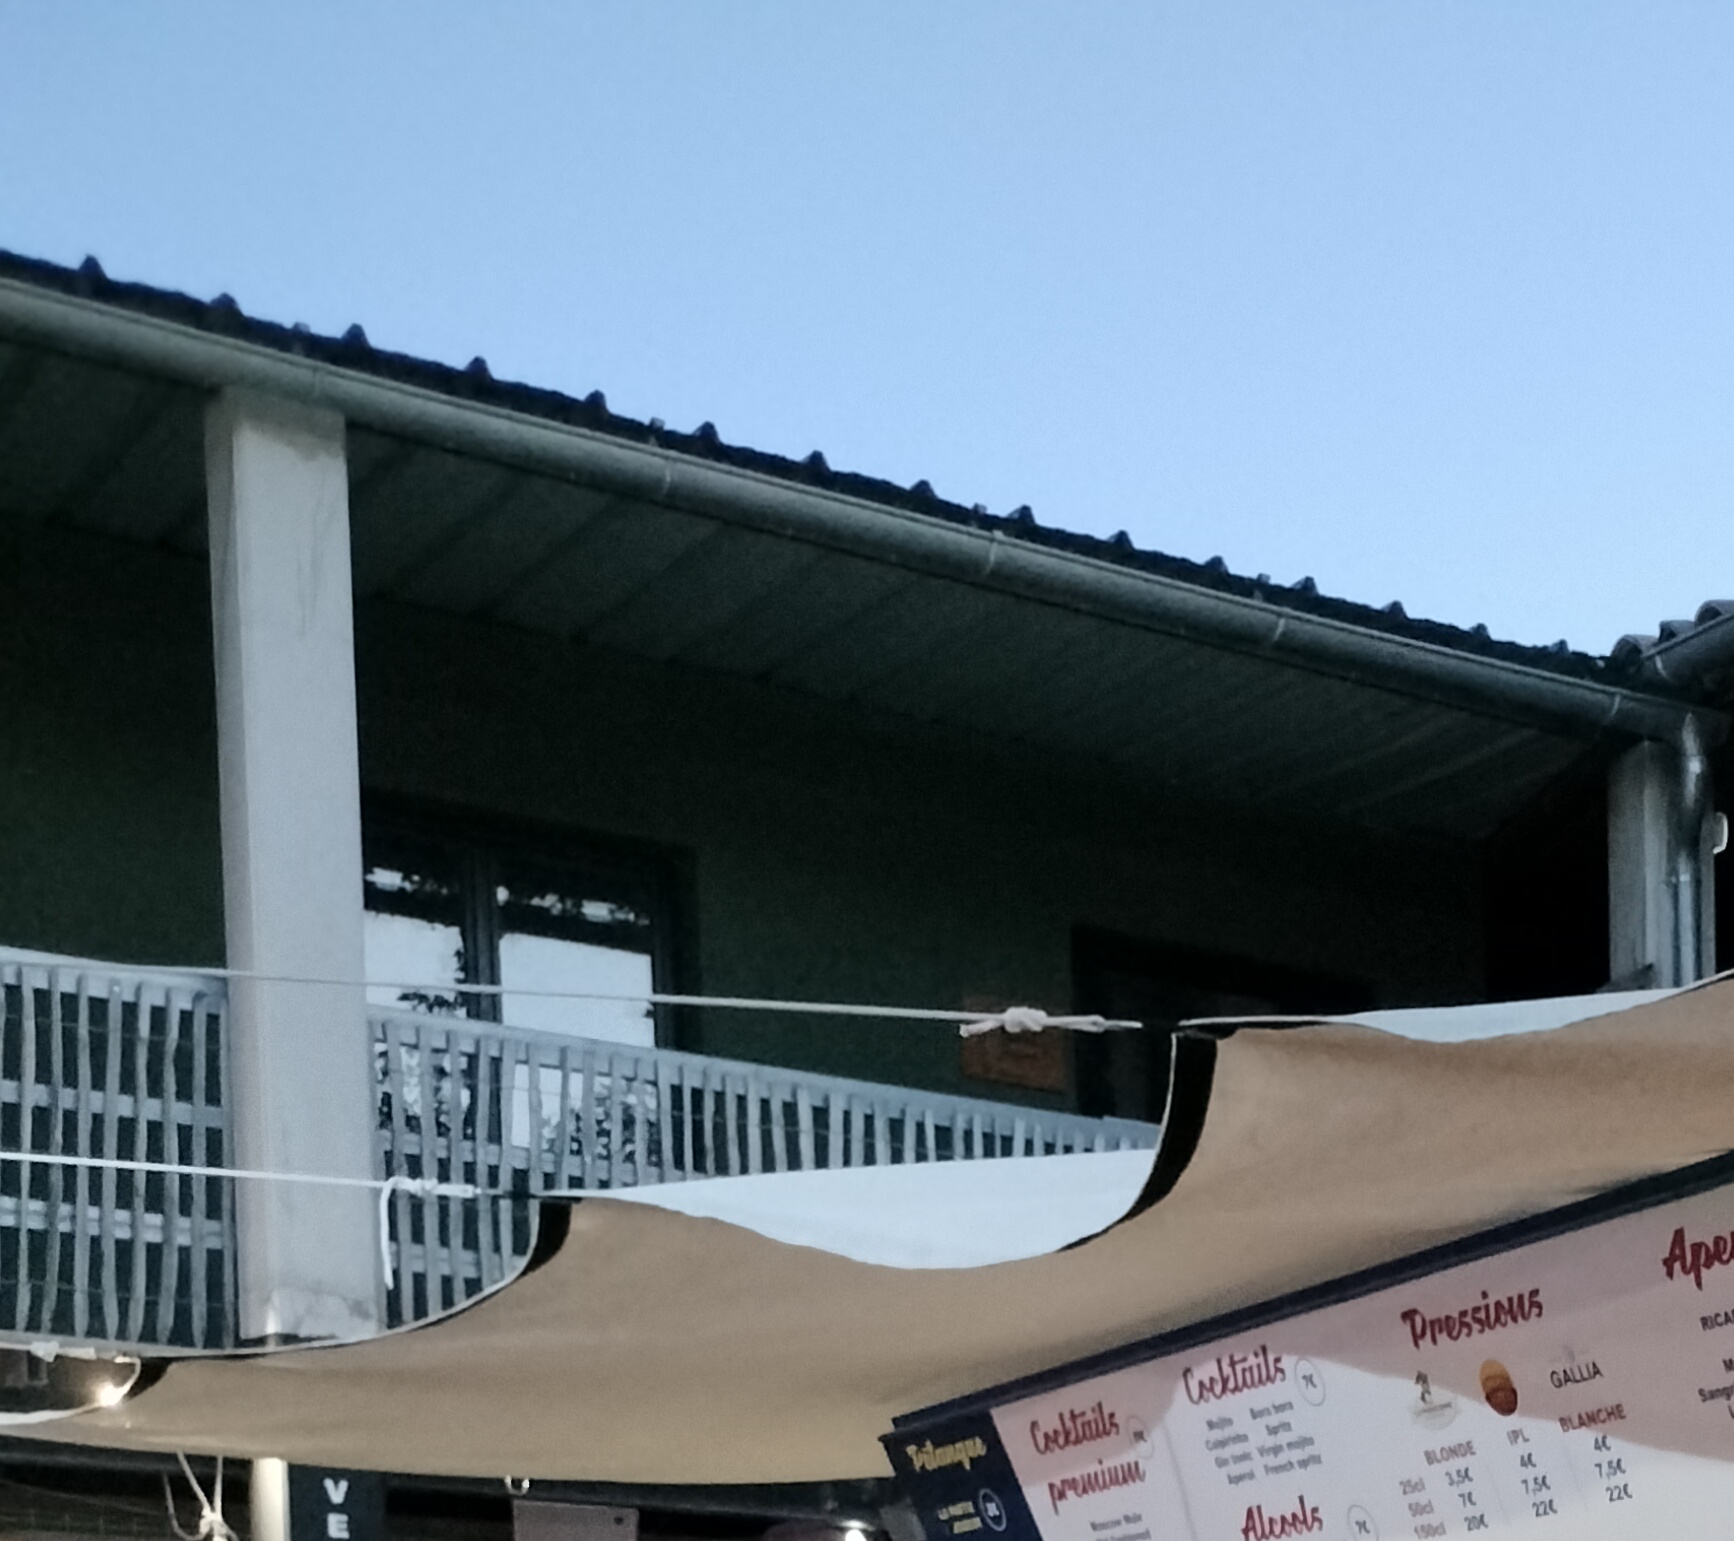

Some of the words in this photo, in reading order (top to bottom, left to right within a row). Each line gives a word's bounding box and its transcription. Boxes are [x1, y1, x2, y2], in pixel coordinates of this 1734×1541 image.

[1400, 1288, 1543, 1350] Pressions
[1182, 1343, 1286, 1405] Cocktails
[1550, 1361, 1603, 1388] GALLIA
[1029, 1401, 1120, 1455] Cocktails
[1424, 1441, 1476, 1466] BLONDE
[1507, 1428, 1530, 1446] IPL
[1559, 1403, 1627, 1432] BLANCHE
[1048, 1458, 1146, 1516] premium
[1399, 1478, 1426, 1495] 25cl
[1445, 1467, 1474, 1487] 3,5€
[1519, 1452, 1537, 1468] 4€
[1594, 1435, 1611, 1451] 4€
[1458, 1491, 1477, 1507] 7€
[1521, 1476, 1551, 1495] 7,5€
[1594, 1458, 1626, 1480] 7,5€
[1464, 1514, 1488, 1532] 20€
[1532, 1499, 1558, 1517] 22€
[1606, 1483, 1633, 1502] 22€
